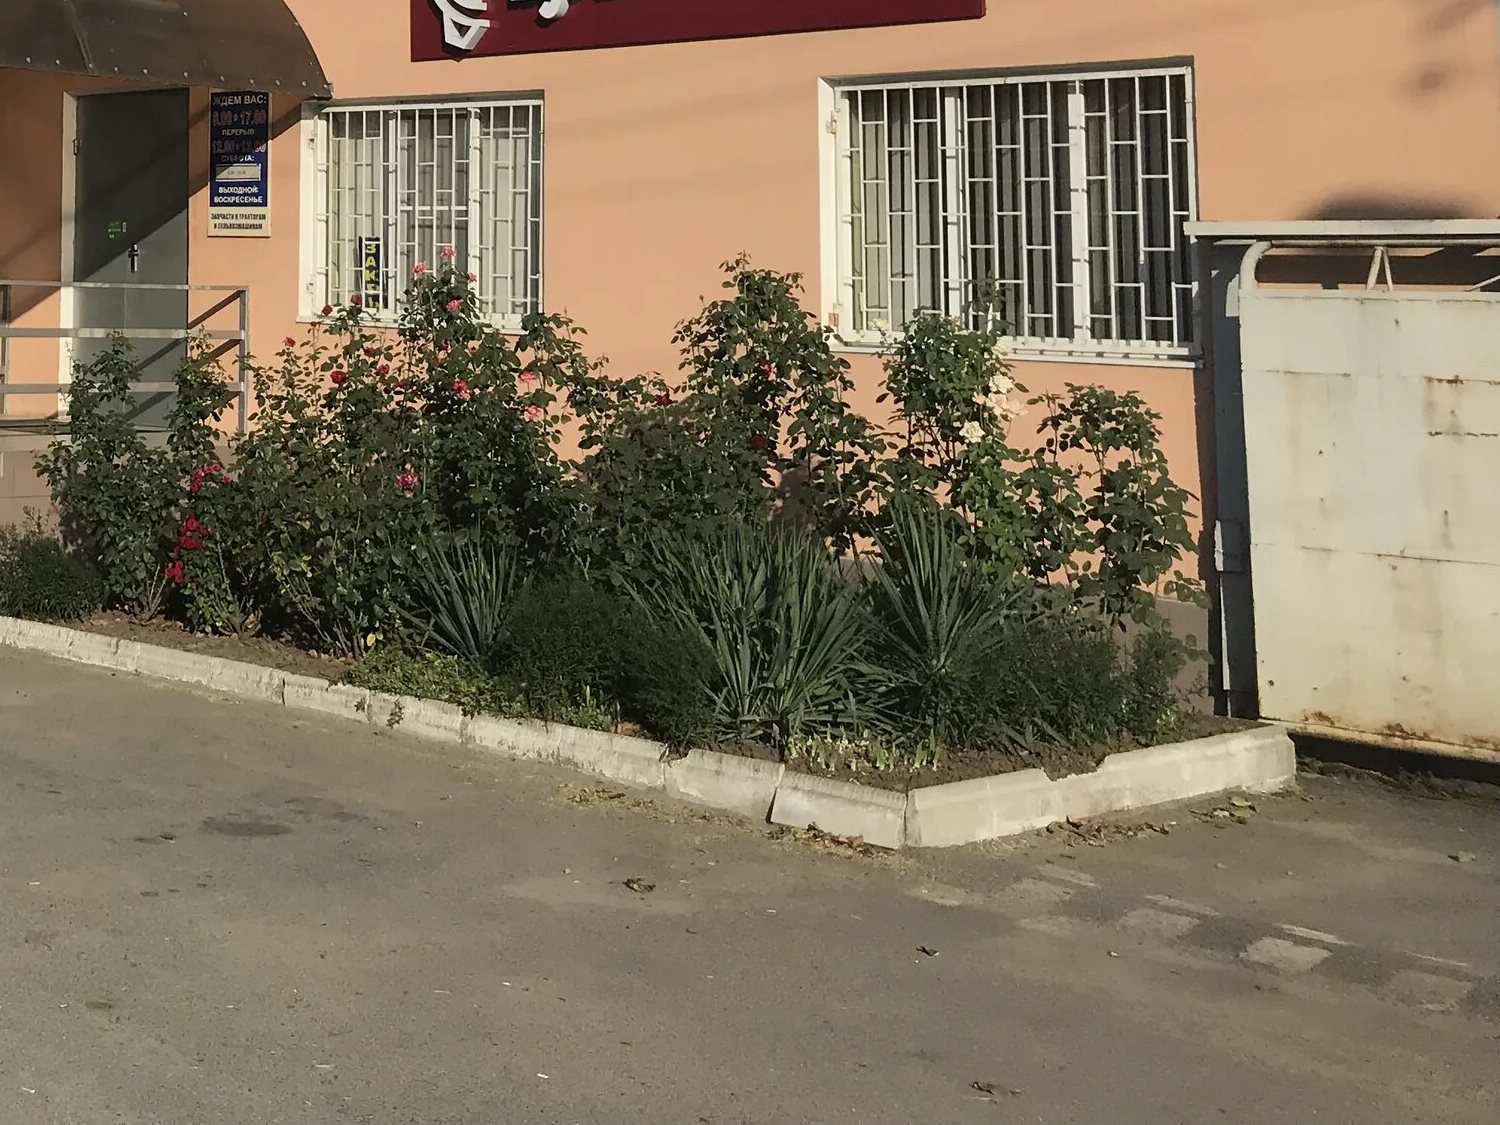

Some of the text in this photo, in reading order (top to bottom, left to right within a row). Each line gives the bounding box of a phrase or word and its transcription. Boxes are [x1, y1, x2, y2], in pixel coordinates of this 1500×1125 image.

[213, 94, 267, 106] ЖДЕМ ВАС:
[213, 195, 263, 203] ВОСКРЕСЕНЬЕ
